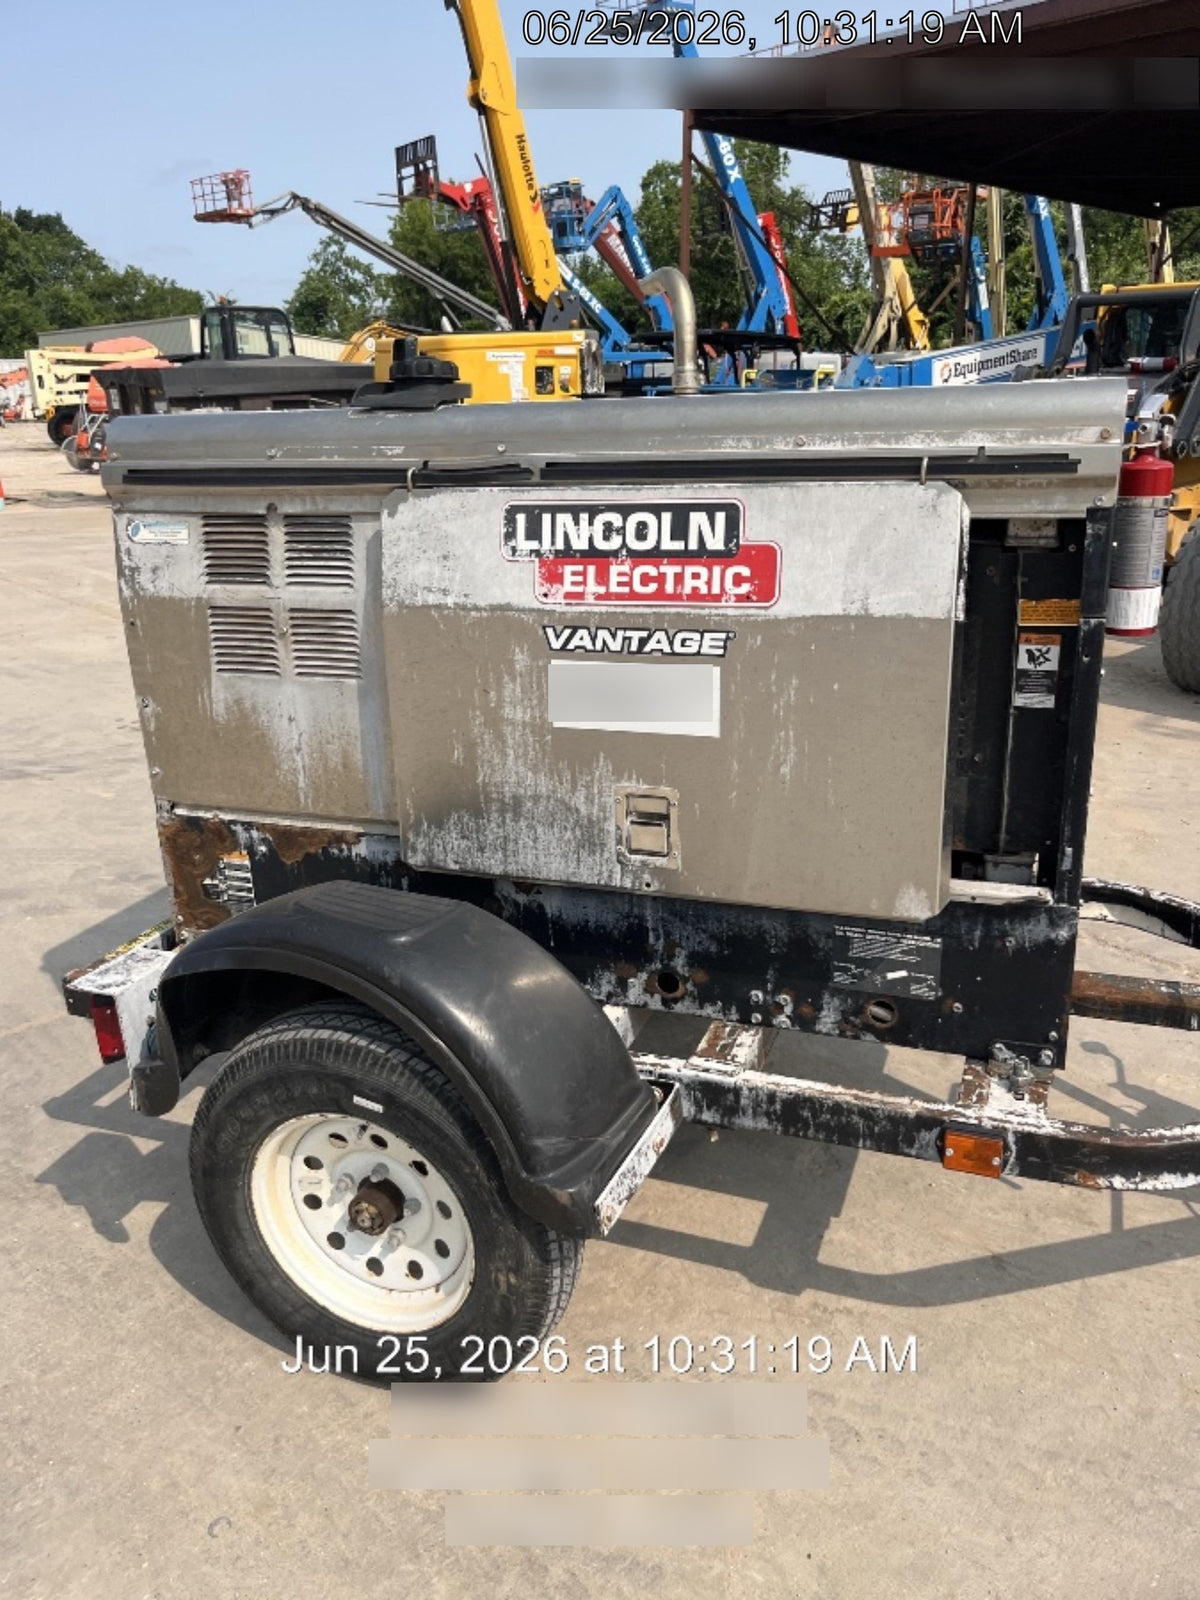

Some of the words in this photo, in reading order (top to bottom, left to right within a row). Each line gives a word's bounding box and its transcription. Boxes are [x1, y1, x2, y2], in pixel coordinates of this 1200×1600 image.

[516, 133, 534, 190] Haulotte
[954, 348, 1037, 378] EquipmentShare
[514, 511, 727, 551] LINCOLN
[562, 565, 752, 595] ELECTRIC
[543, 625, 729, 657] VANTAGE
